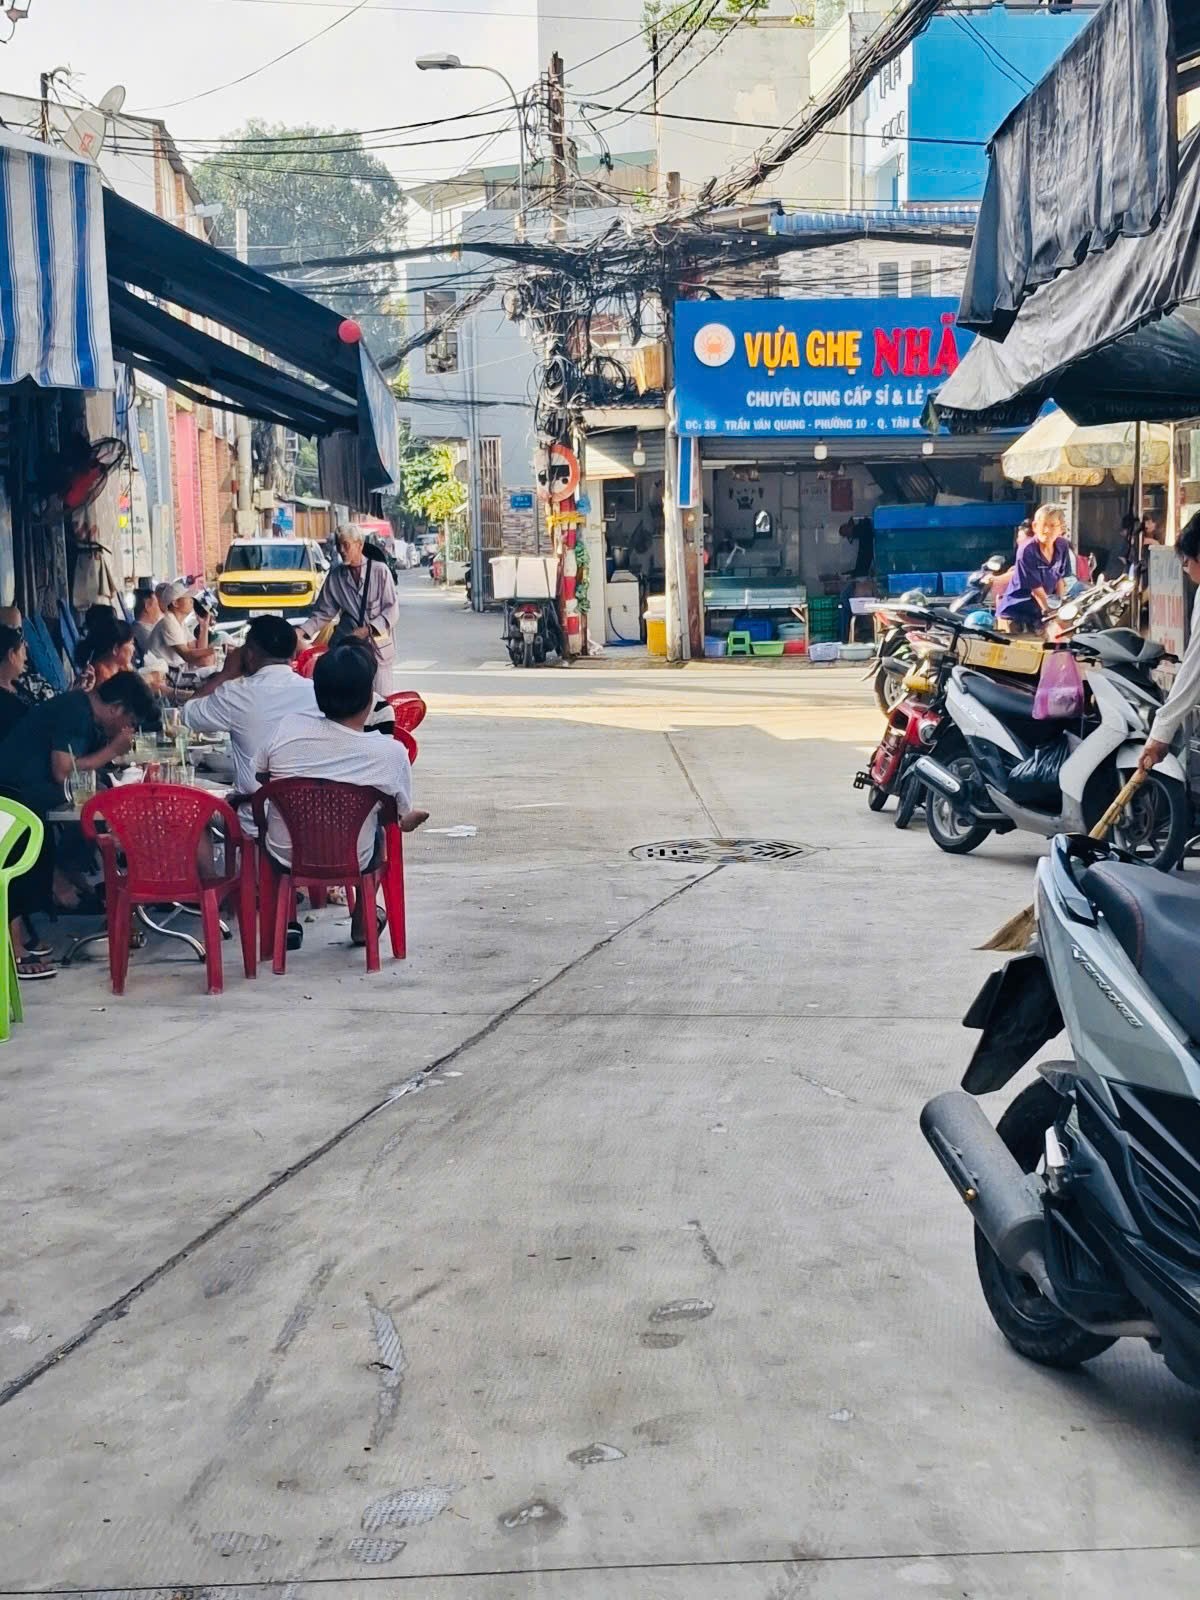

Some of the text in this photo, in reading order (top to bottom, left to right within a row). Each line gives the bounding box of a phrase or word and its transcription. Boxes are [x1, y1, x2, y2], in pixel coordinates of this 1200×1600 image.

[744, 325, 800, 376] VỰA
[806, 330, 862, 375] GHẸ
[746, 383, 924, 407] CHUYÊN CUNG CẤP SỈ & LẺ
[773, 419, 805, 431] QUANG
[815, 416, 853, 429] PHƯỜNG
[856, 418, 867, 429] 10
[877, 418, 888, 430] Q.
[891, 416, 909, 429] TÂN
